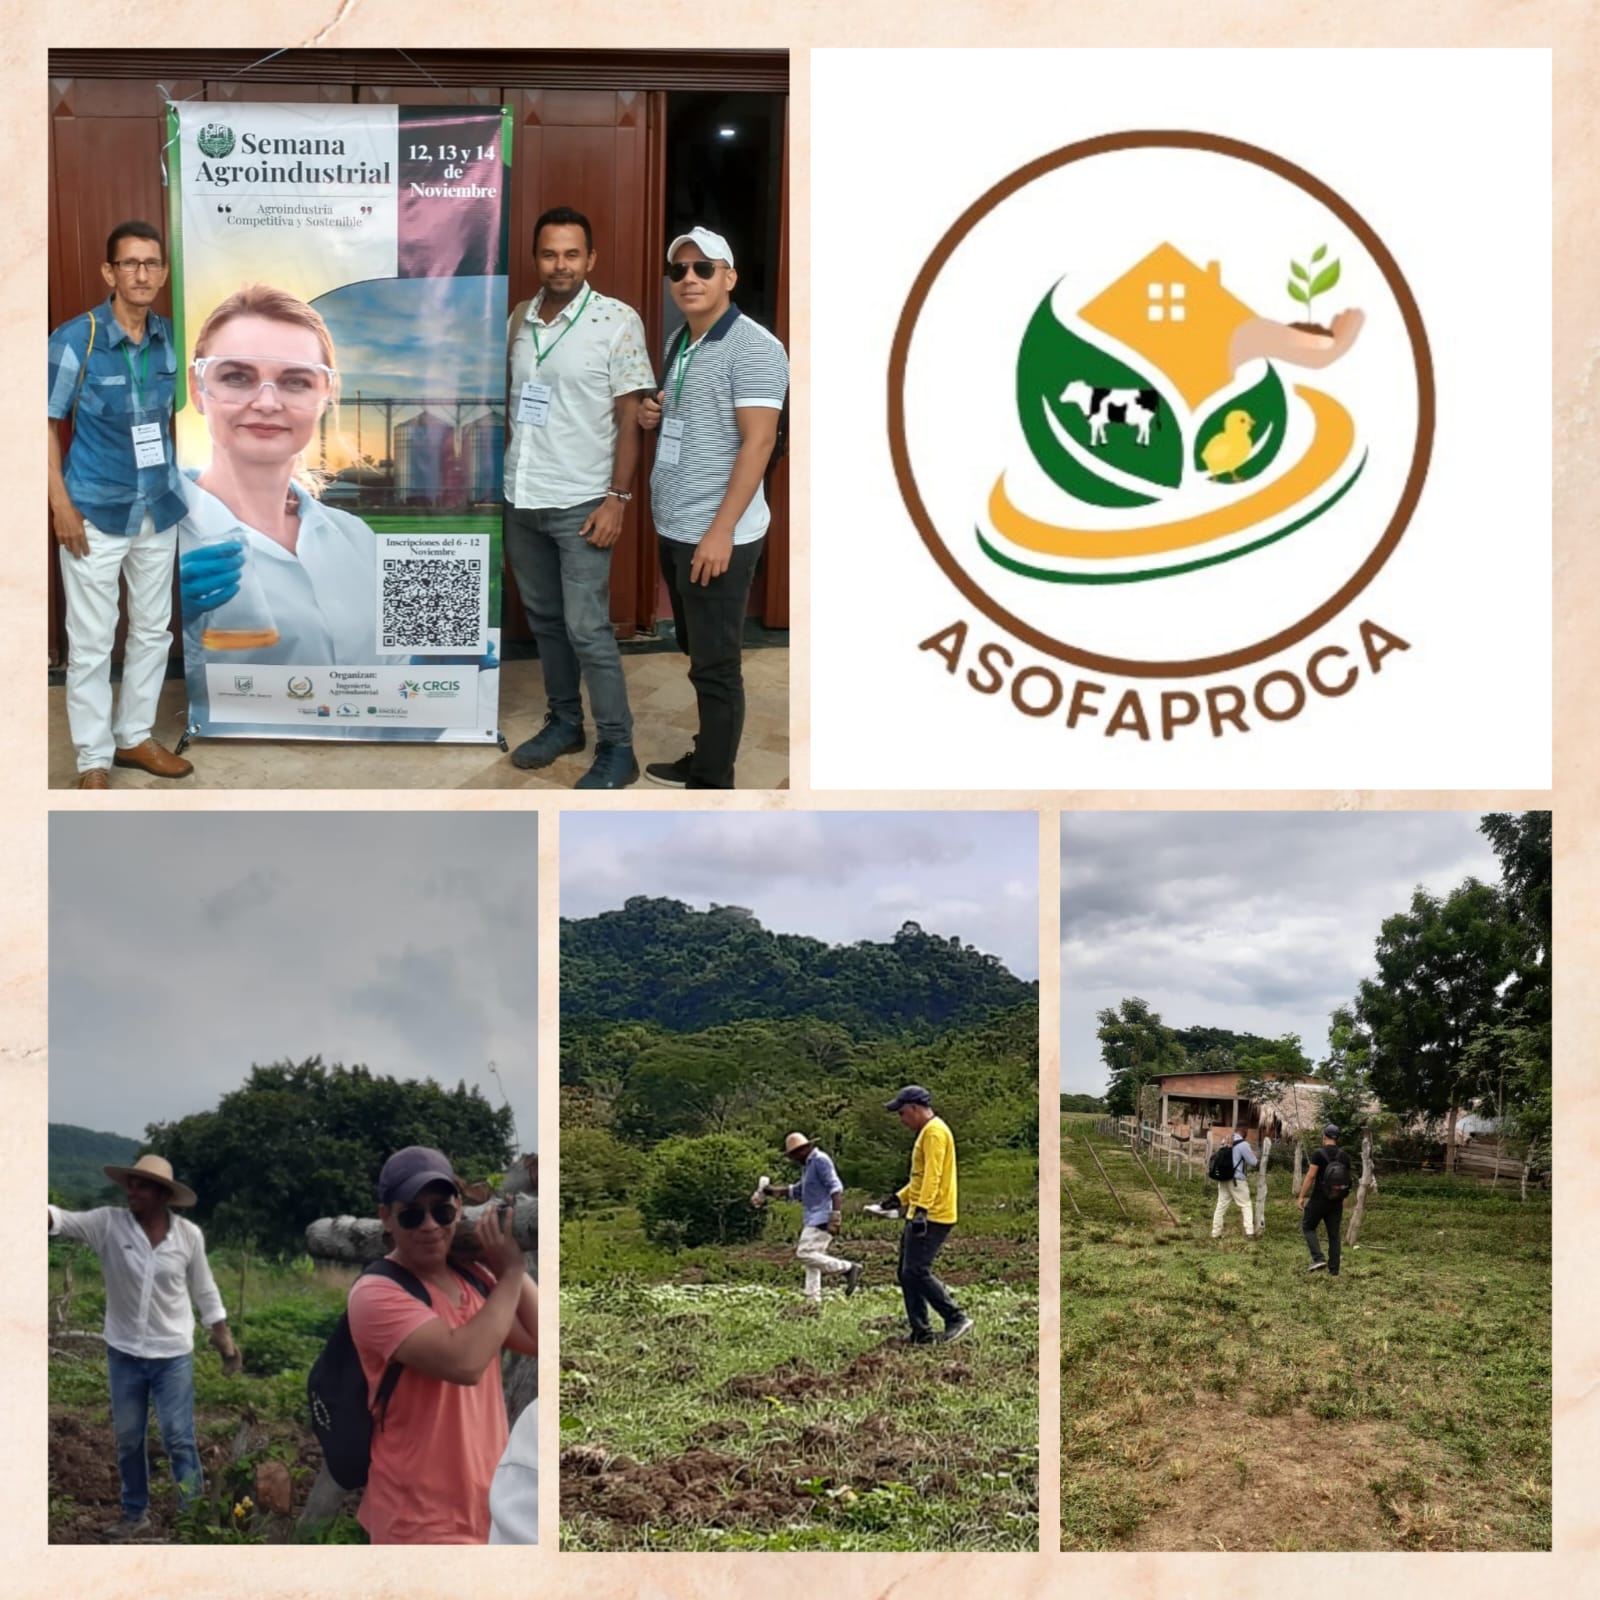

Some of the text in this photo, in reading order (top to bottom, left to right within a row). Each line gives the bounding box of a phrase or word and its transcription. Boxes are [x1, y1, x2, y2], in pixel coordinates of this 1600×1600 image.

[241, 133, 345, 155] Semana
[409, 144, 496, 164] 12, 13 y 14
[195, 160, 392, 188] Agroindustrial
[443, 164, 463, 179] de
[410, 182, 497, 198] Noviembre
[255, 203, 334, 215] Agroindustria
[226, 215, 363, 229] Competitiva y Sostenible
[386, 538, 440, 548] Inscripciones
[442, 538, 454, 547] del
[456, 538, 462, 546] 6
[470, 538, 480, 547] 12
[410, 547, 456, 556] Noviembre
[329, 671, 377, 681] Organizan:
[918, 619, 1412, 741] ASOFAPROCA
[423, 680, 460, 691] CRCIS
